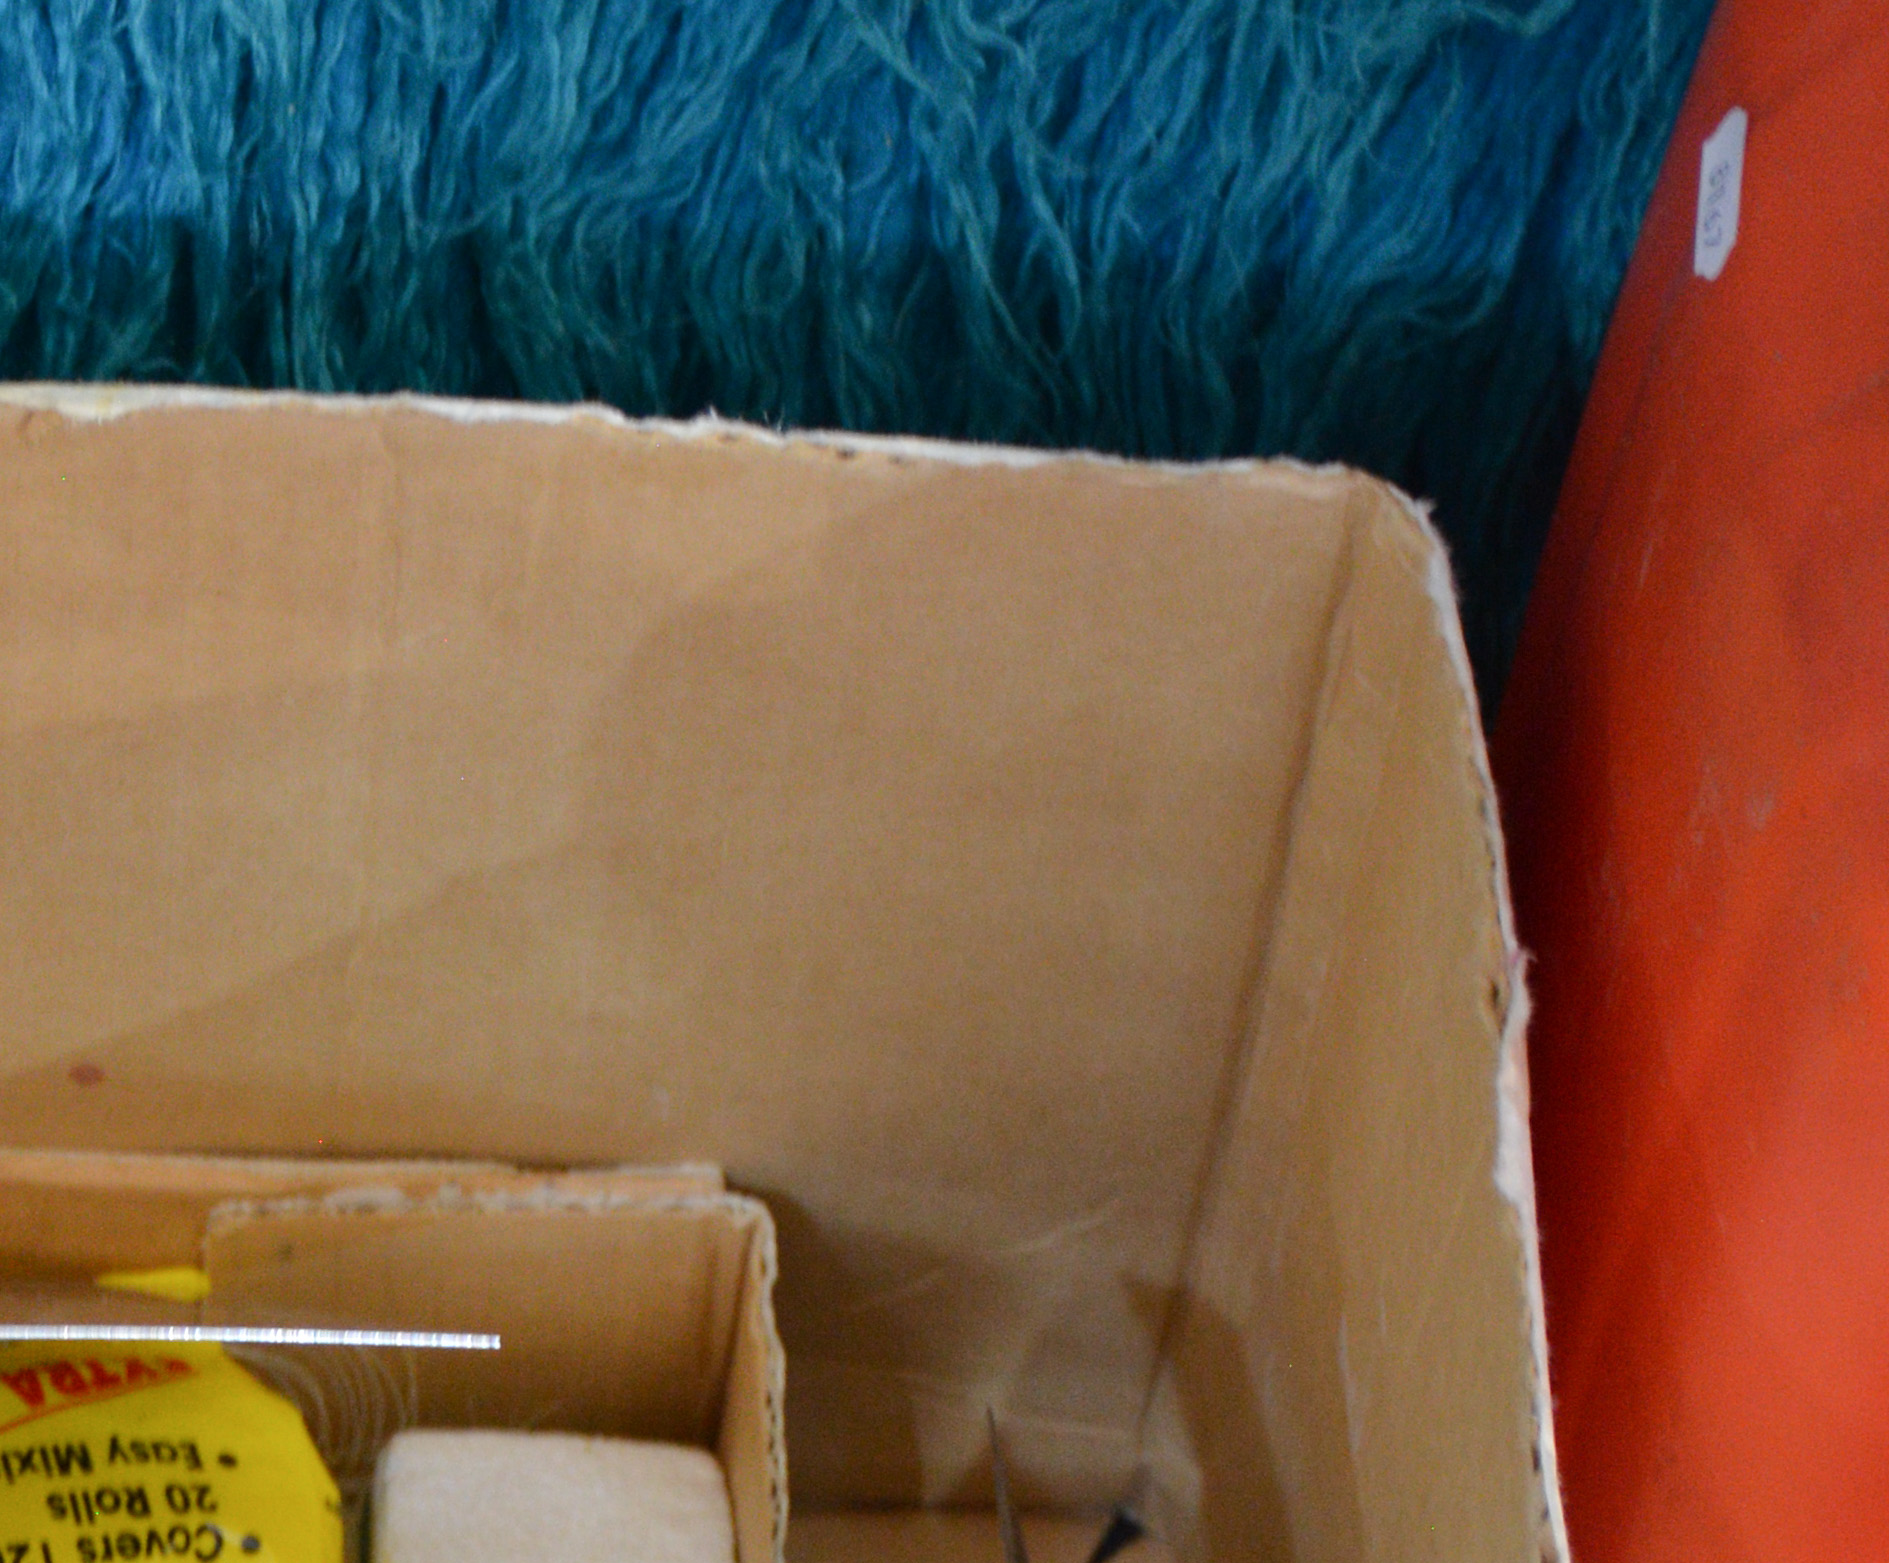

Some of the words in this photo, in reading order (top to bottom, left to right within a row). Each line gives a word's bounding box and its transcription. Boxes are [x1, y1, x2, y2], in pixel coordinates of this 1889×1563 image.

[107, 1434, 203, 1471] Easy
[45, 1484, 152, 1527] Rolls
[164, 1482, 218, 1515] 20
